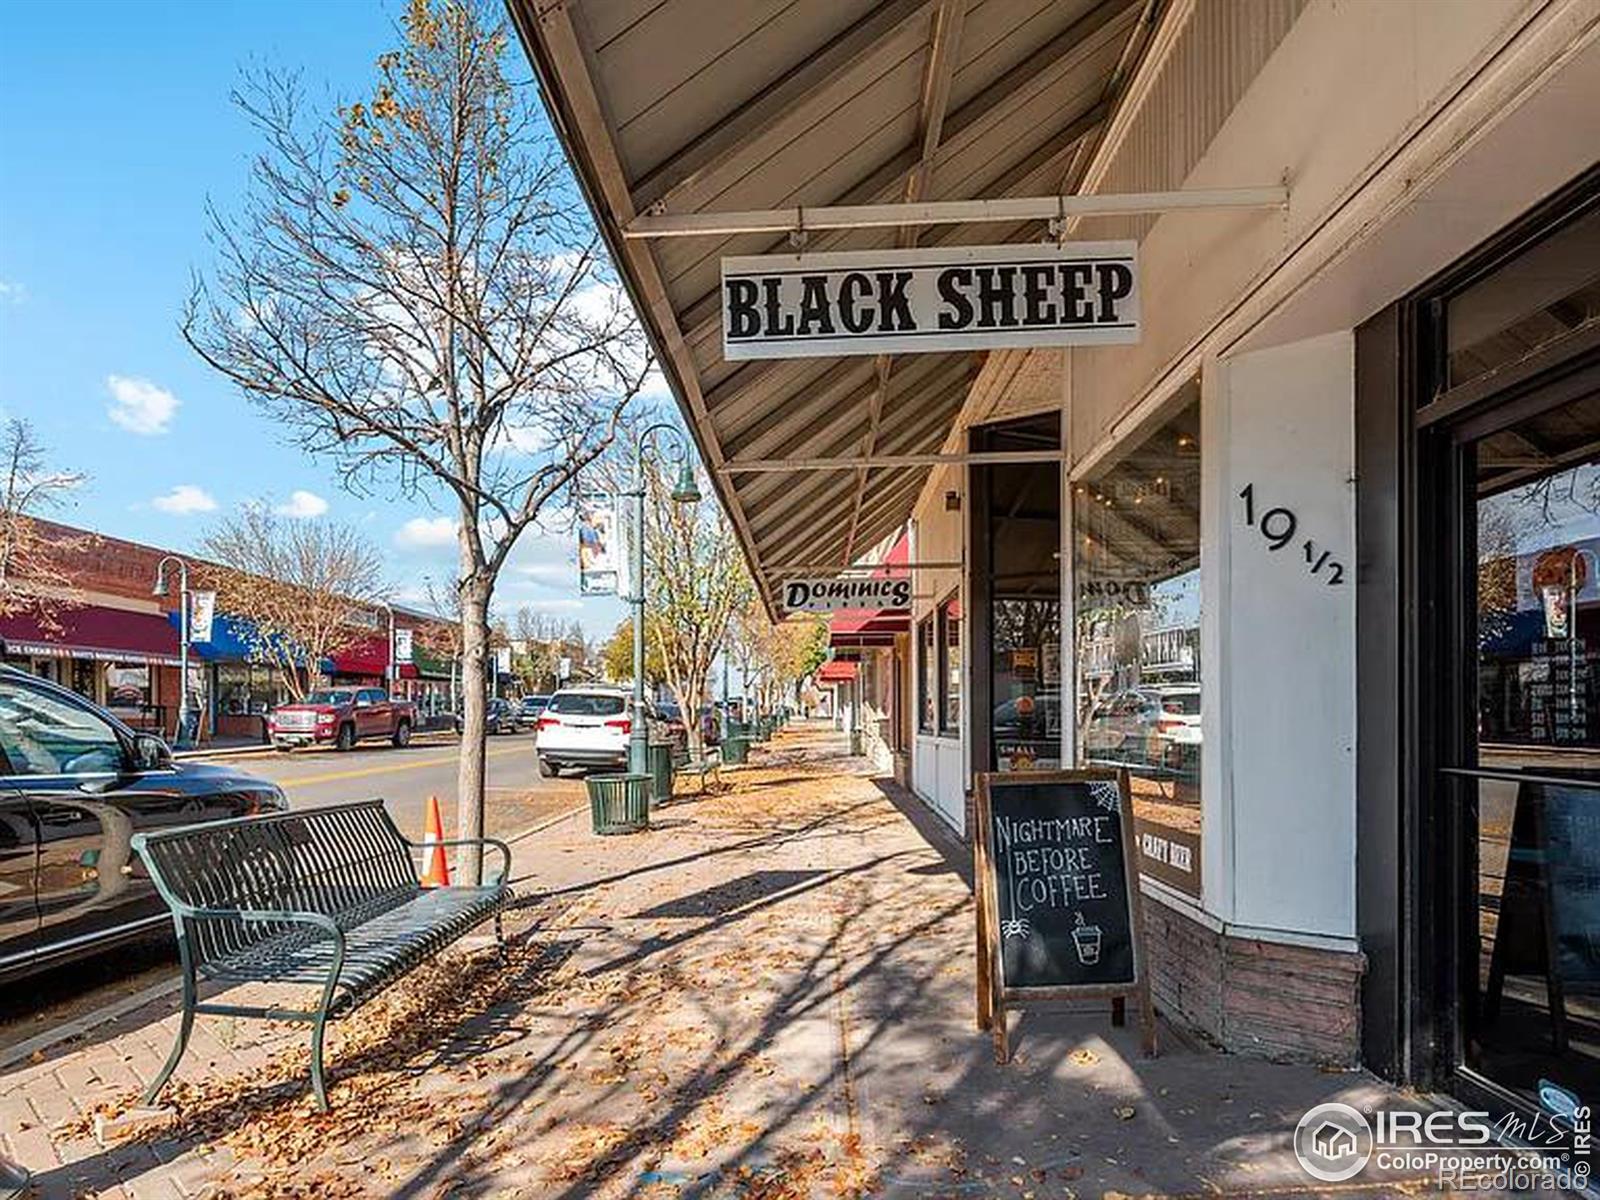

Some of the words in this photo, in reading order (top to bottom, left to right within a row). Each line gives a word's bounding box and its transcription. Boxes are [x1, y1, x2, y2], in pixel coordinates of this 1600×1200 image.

[725, 272, 918, 338] BLACK
[937, 263, 1133, 330] SHEEP
[1239, 483, 1297, 551] 19
[995, 816, 1112, 852] NIGHTMARE
[1014, 847, 1093, 876] BEFORE
[1017, 873, 1108, 911] COFFEE
